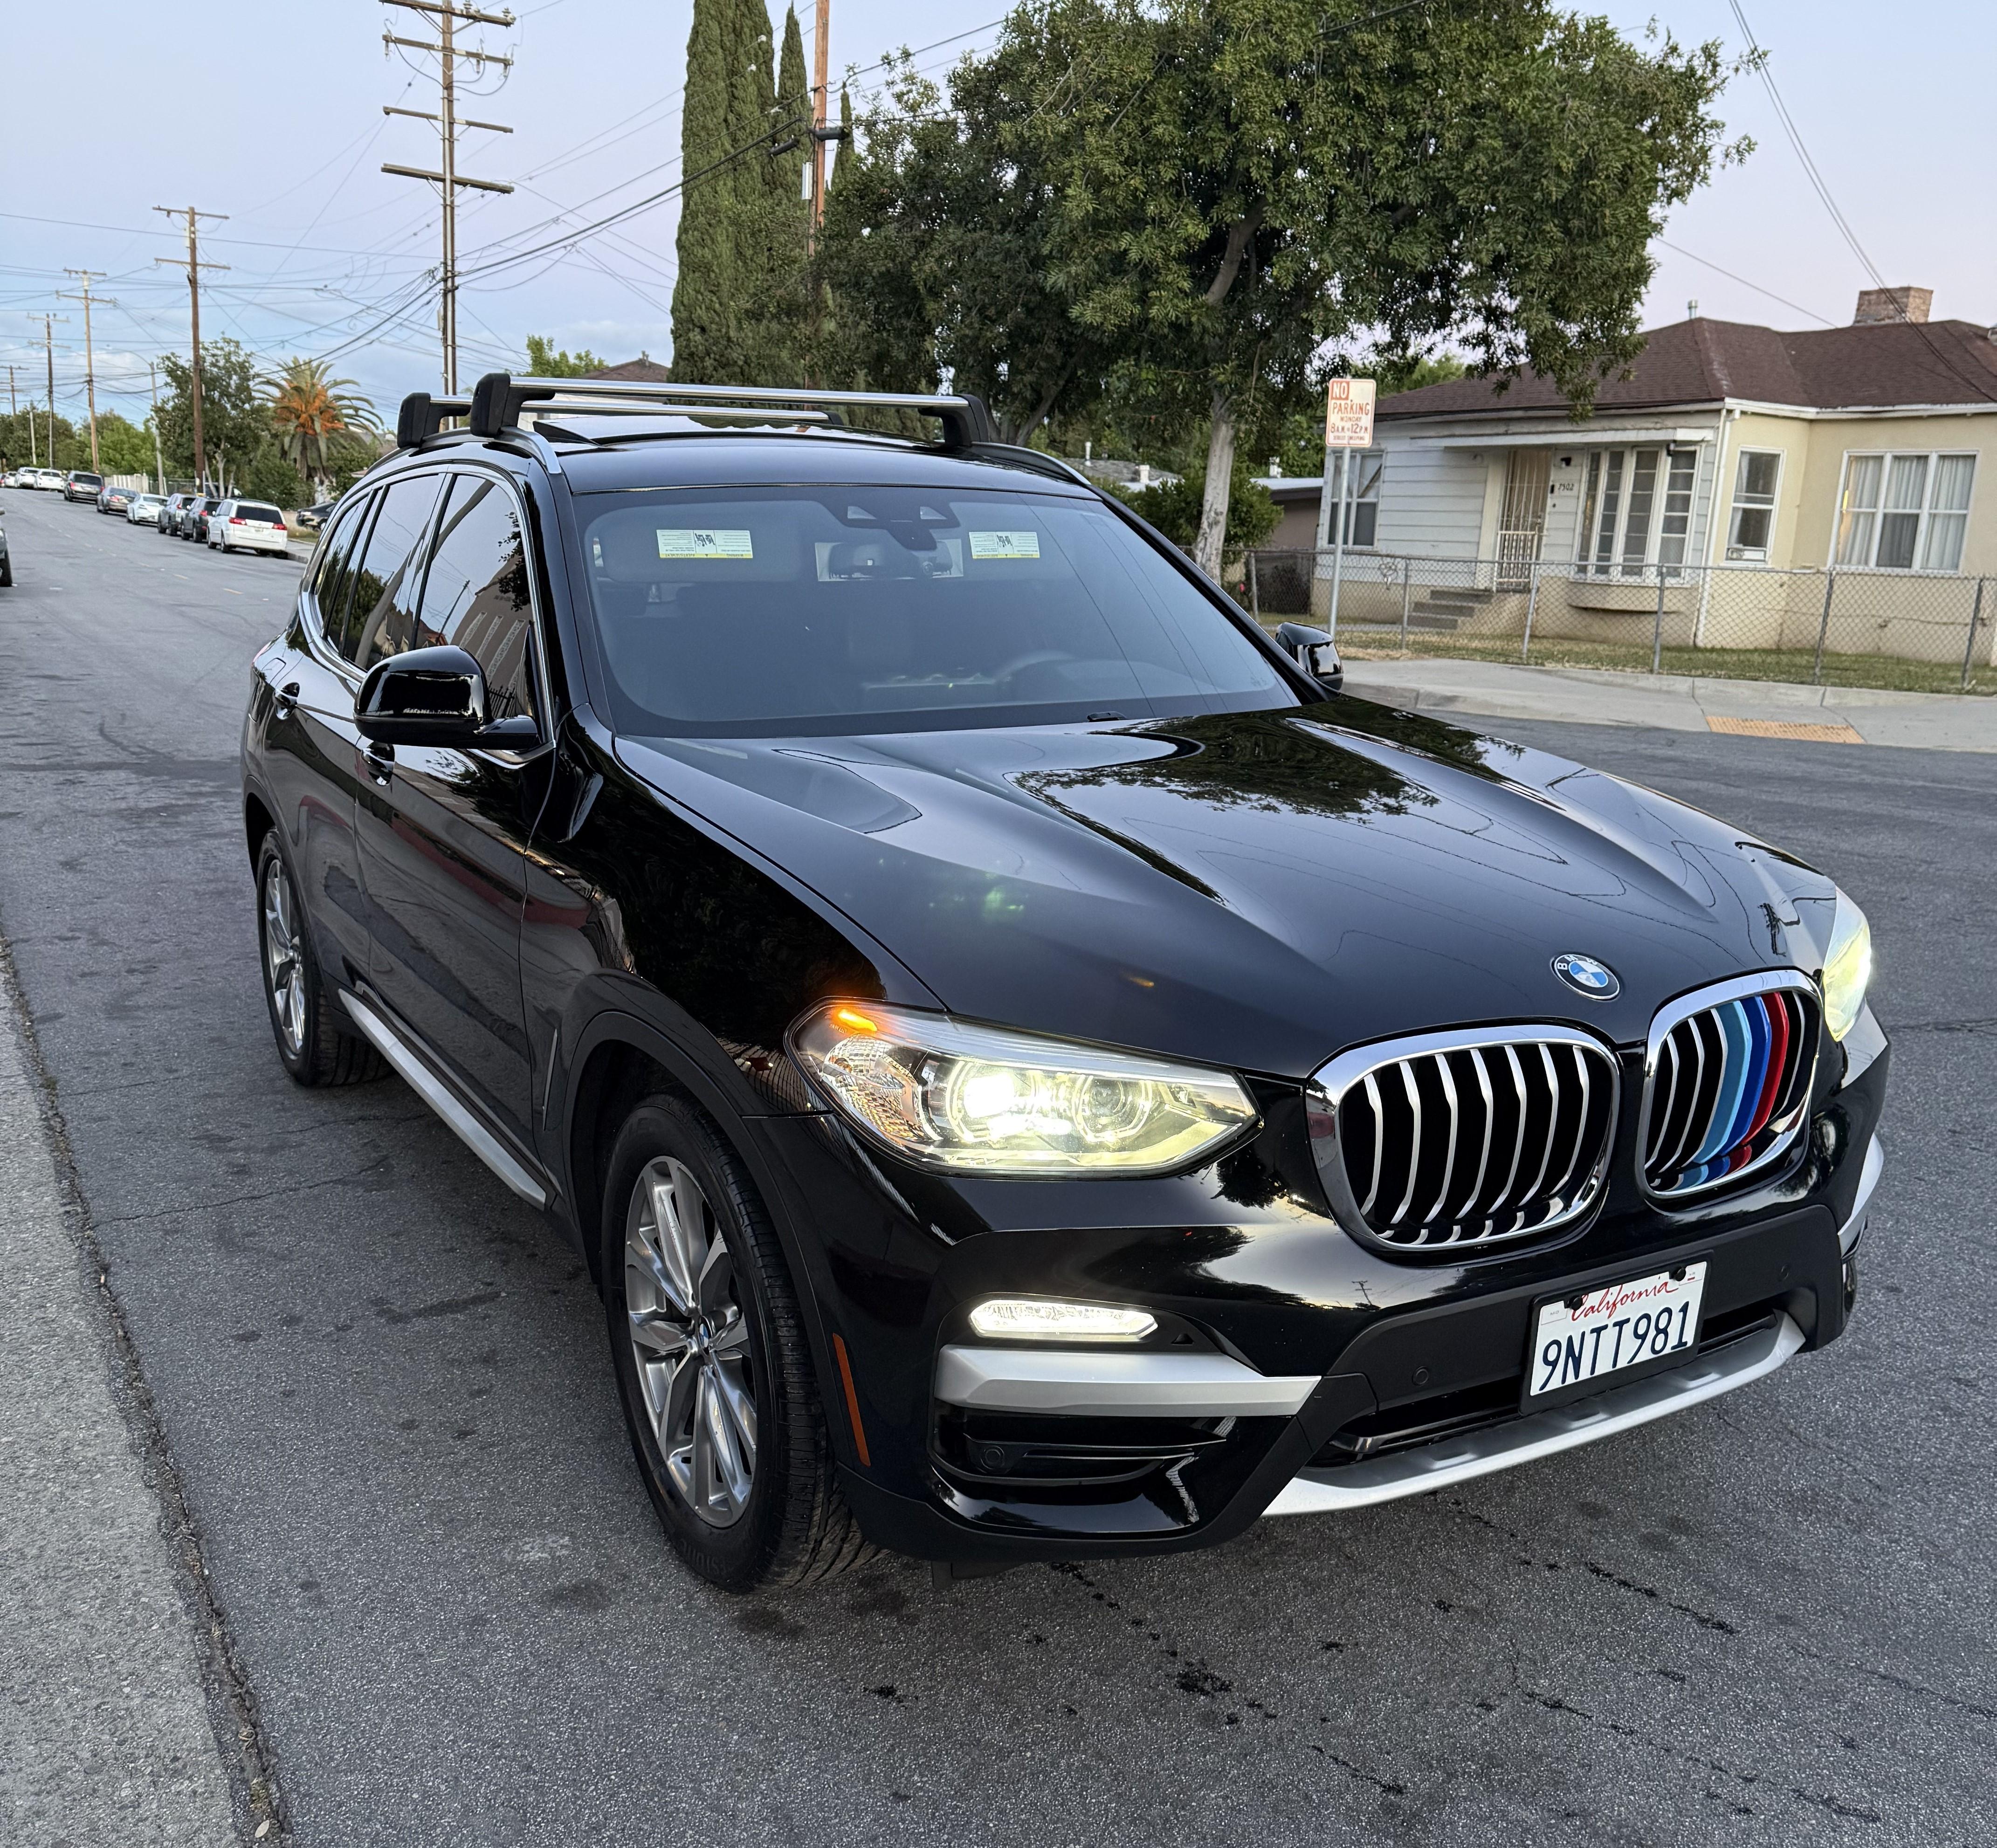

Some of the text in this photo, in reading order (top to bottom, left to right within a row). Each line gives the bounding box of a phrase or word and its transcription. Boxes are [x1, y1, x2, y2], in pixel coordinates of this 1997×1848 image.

[1333, 382, 1348, 398] NO
[1332, 402, 1370, 415] PARKING
[1557, 955, 1598, 970] BMW
[1571, 1276, 1678, 1322] California
[1539, 1300, 1690, 1391] 9NTT981
